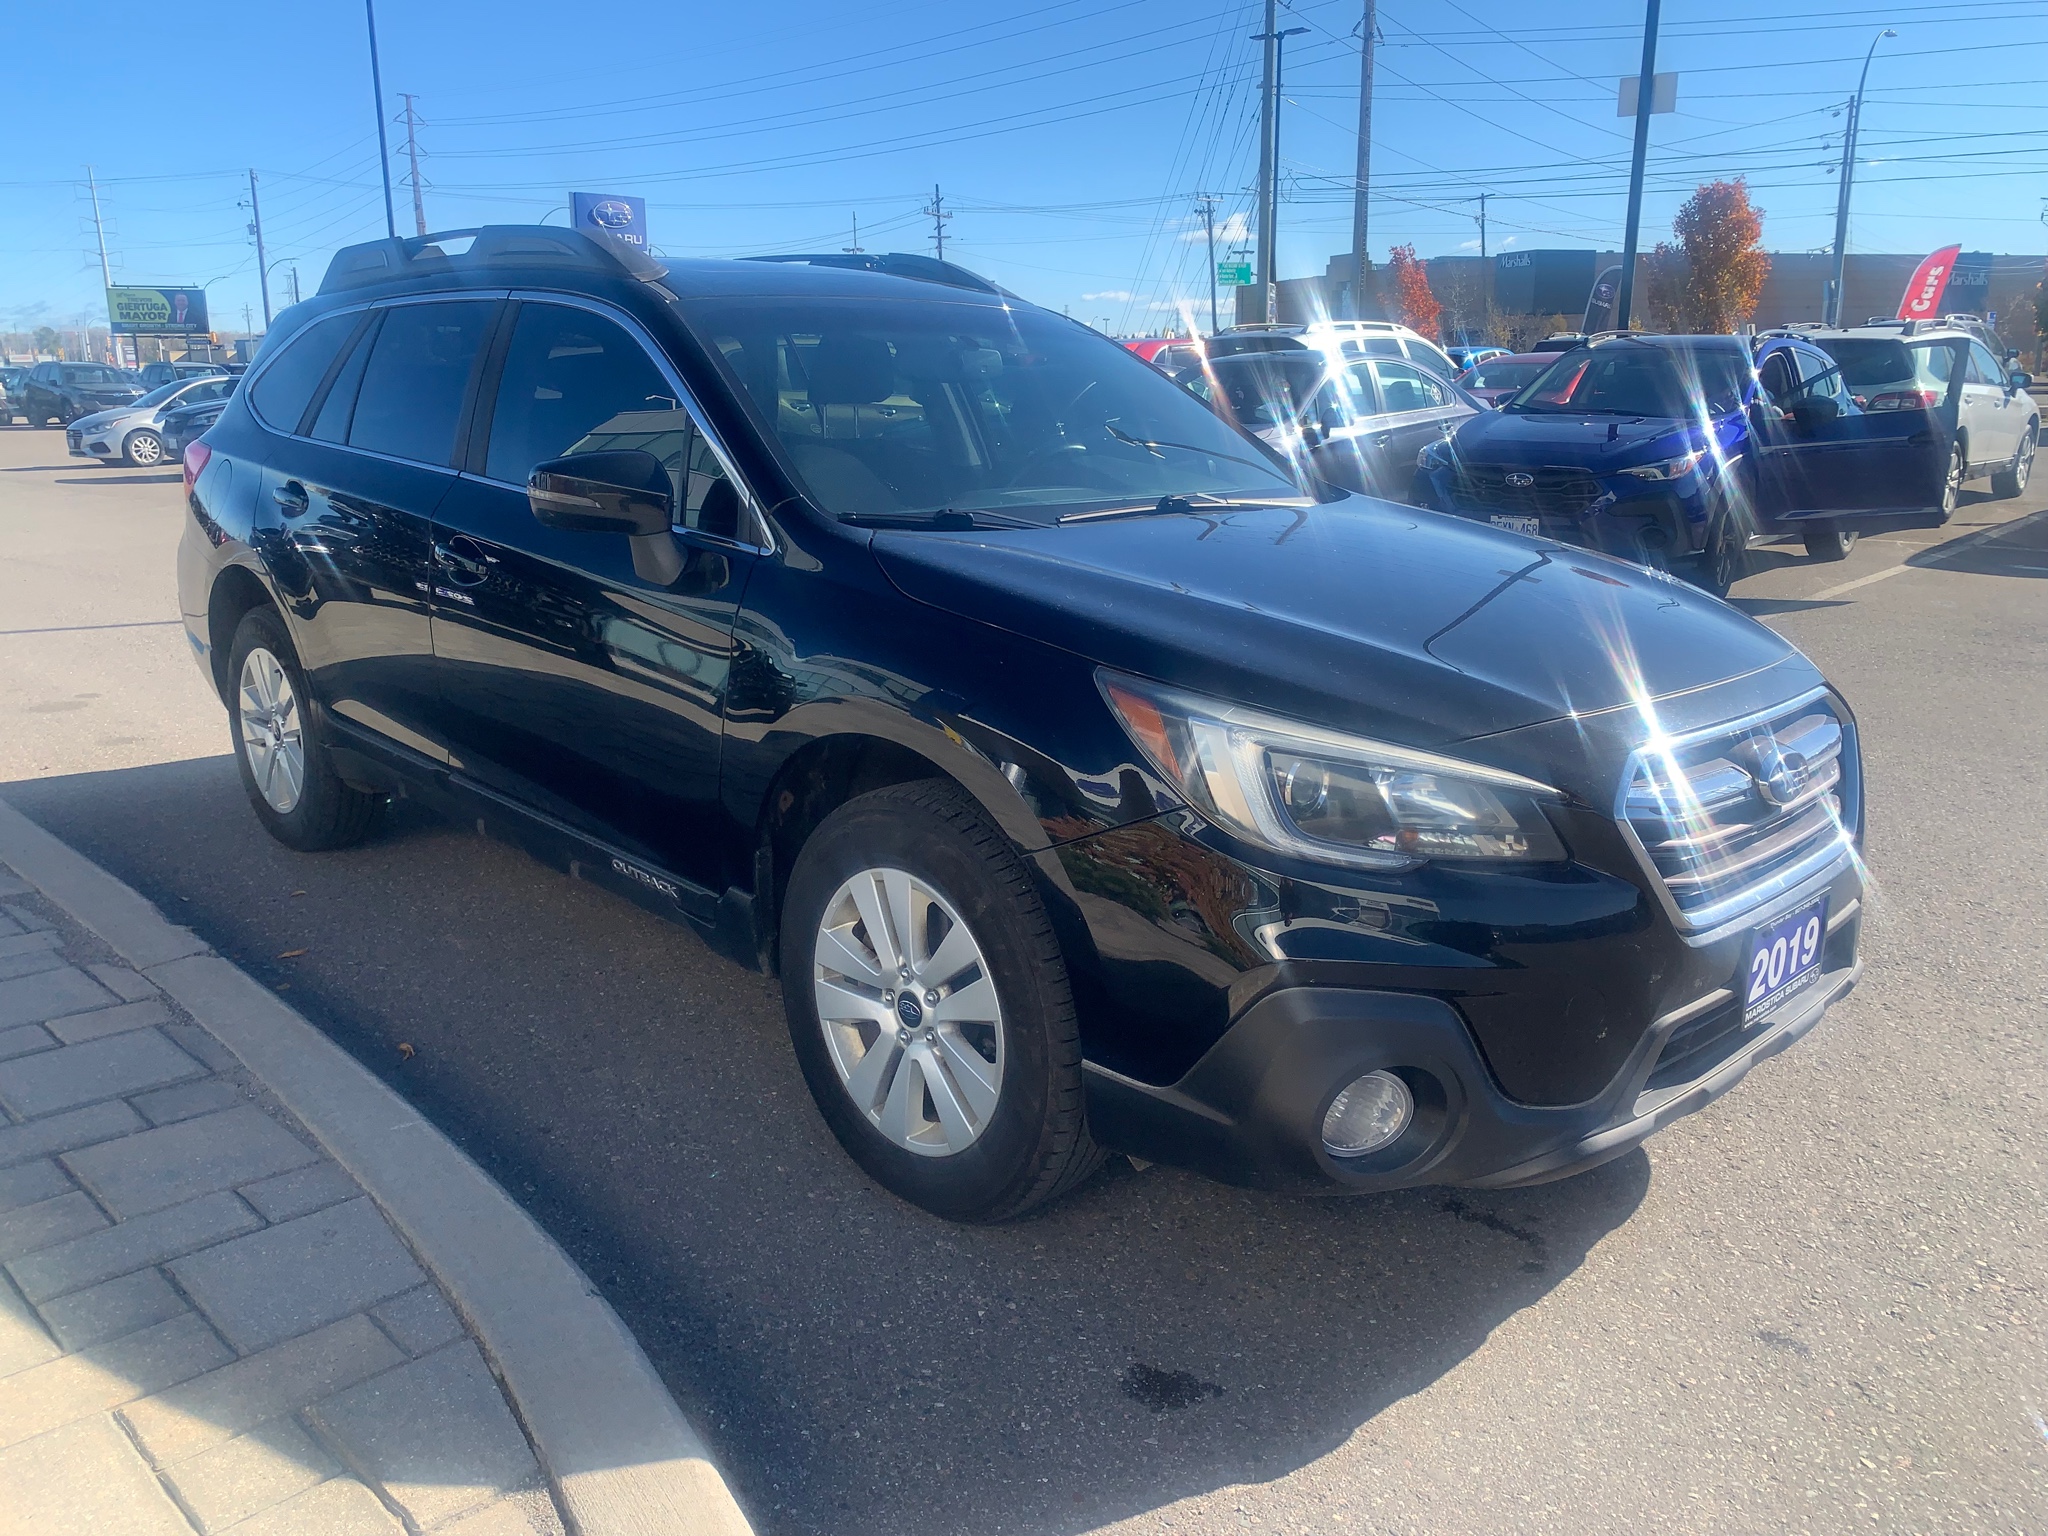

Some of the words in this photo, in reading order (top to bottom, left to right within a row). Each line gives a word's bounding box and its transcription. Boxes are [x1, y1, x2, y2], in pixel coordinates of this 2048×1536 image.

[1500, 253, 1532, 268] Marshalls
[1911, 266, 1945, 312] Cars
[1948, 272, 1988, 286] Marshalls
[117, 302, 168, 312] GIERTUGA
[120, 311, 167, 321] MAYOR
[612, 859, 678, 898] OUTBACK
[1748, 916, 1820, 1004] 2019
[1744, 990, 1785, 1023] MAROSTICA
[1784, 973, 1810, 996] SUBARU
